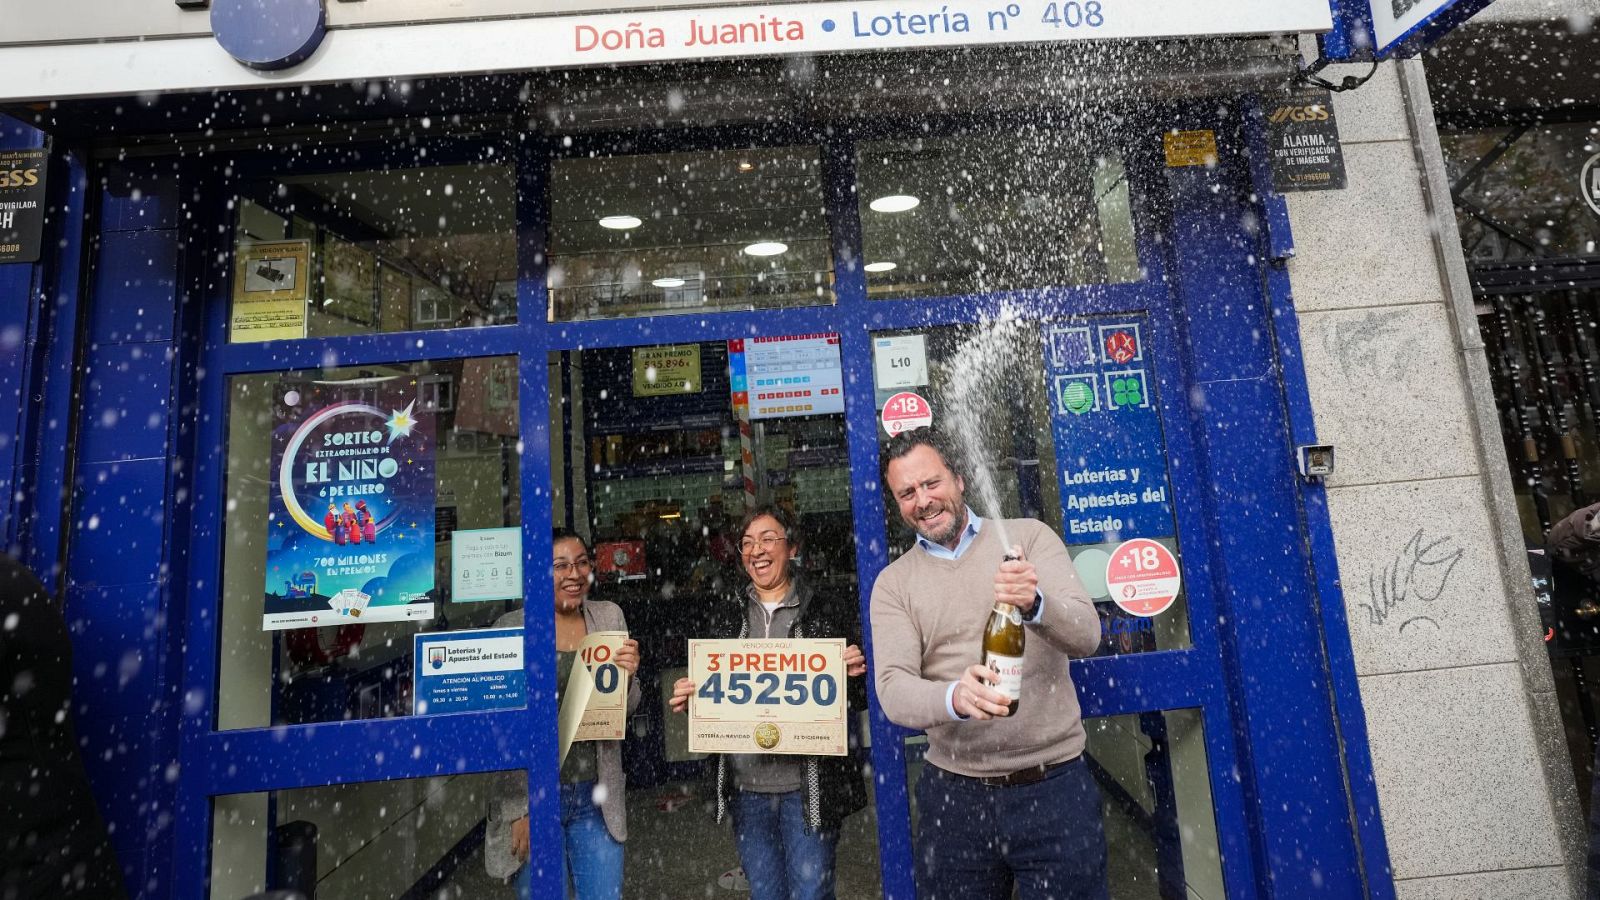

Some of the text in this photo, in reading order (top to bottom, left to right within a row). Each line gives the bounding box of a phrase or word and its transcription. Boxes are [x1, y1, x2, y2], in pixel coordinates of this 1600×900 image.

[575, 1, 1104, 52] Doña Juanita Lotería nº 408
[1289, 104, 1329, 122] GSS
[1274, 145, 1336, 157] CON VERIFICACIÓN
[1286, 155, 1330, 165] DE IMÁGENES
[664, 350, 693, 358] PREMIO
[891, 357, 911, 368] L10
[642, 382, 673, 390] VENDIDO
[891, 397, 919, 413] +18
[324, 430, 383, 446] SORTEO
[315, 446, 390, 458] EXTRAORDINARIO DE
[306, 457, 399, 483] EL NIÑO
[1064, 466, 1140, 485] Loterías y
[320, 483, 385, 497] 6 DE ENERO
[1067, 486, 1166, 513] Apuestas del
[1069, 515, 1123, 534] Estado
[314, 553, 388, 568] 700 MILLONES
[1119, 546, 1160, 571] +18
[326, 565, 376, 577] EN PREMIOS
[448, 652, 518, 664] Apuestas del Estado
[729, 653, 827, 672] PREMIO
[442, 676, 471, 684] ATENCIÓN
[698, 672, 838, 707] 45250
